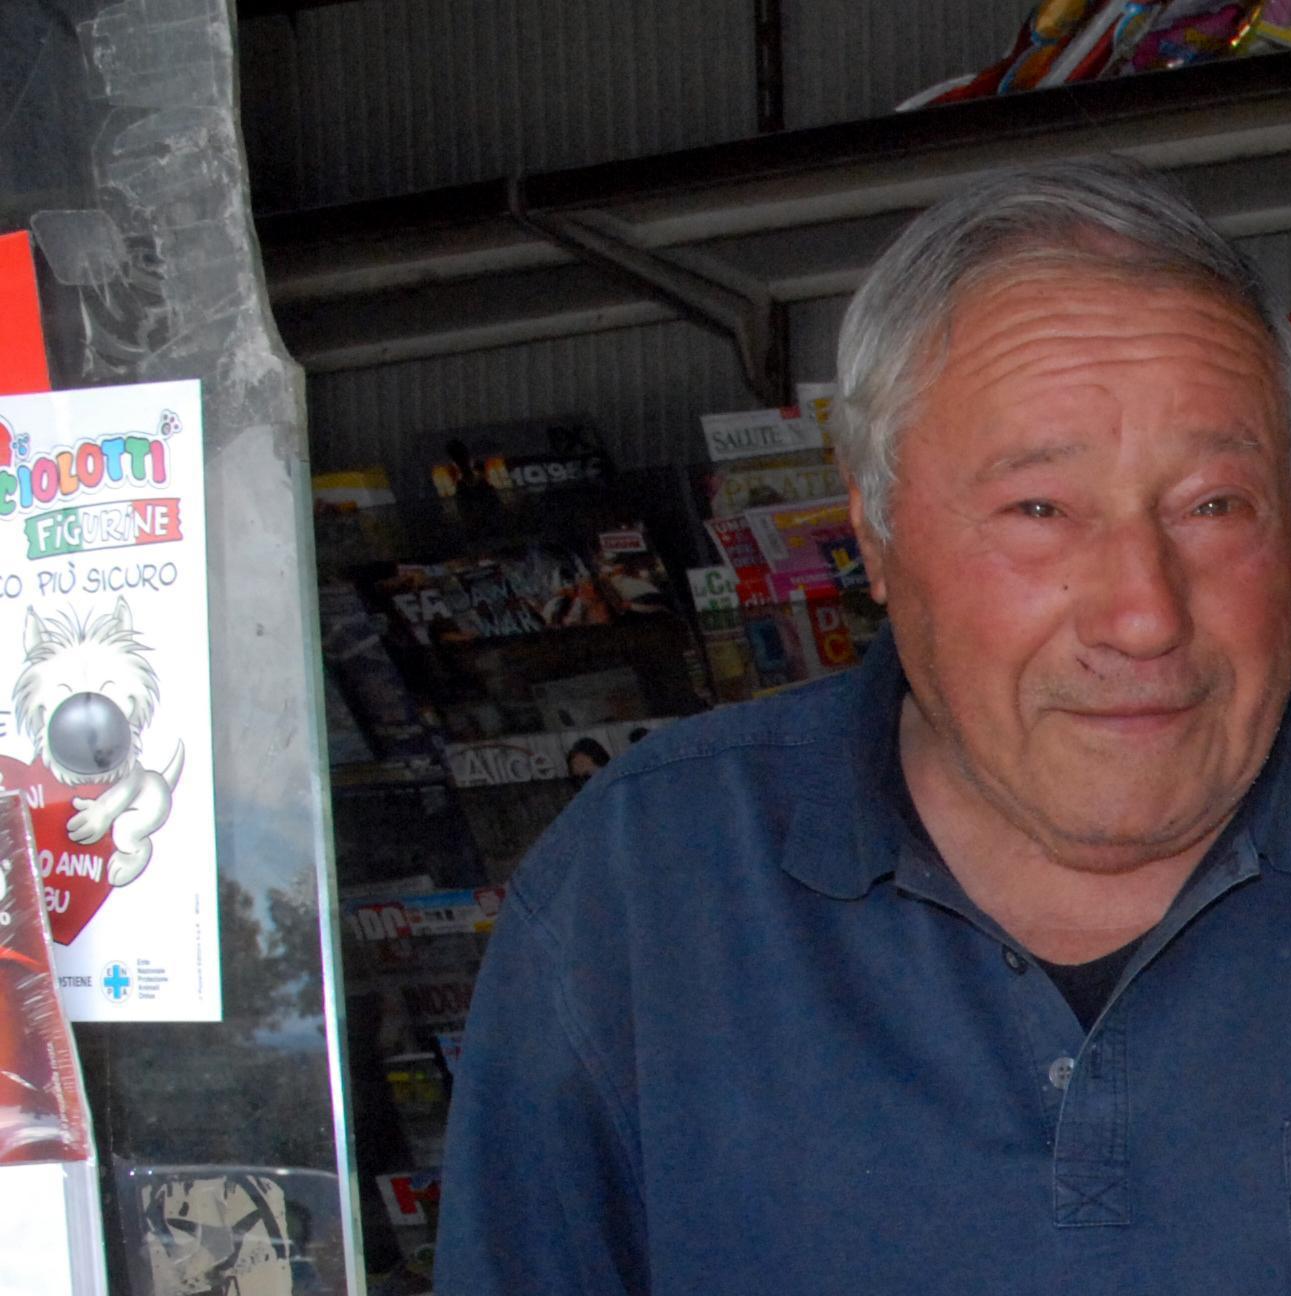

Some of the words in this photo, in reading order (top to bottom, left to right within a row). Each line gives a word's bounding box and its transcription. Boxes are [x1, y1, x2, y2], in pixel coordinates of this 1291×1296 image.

[711, 424, 784, 451] SALUTE
[37, 561, 77, 596] PIÙ
[82, 561, 179, 592] SICURO
[56, 852, 104, 883] ANNI
